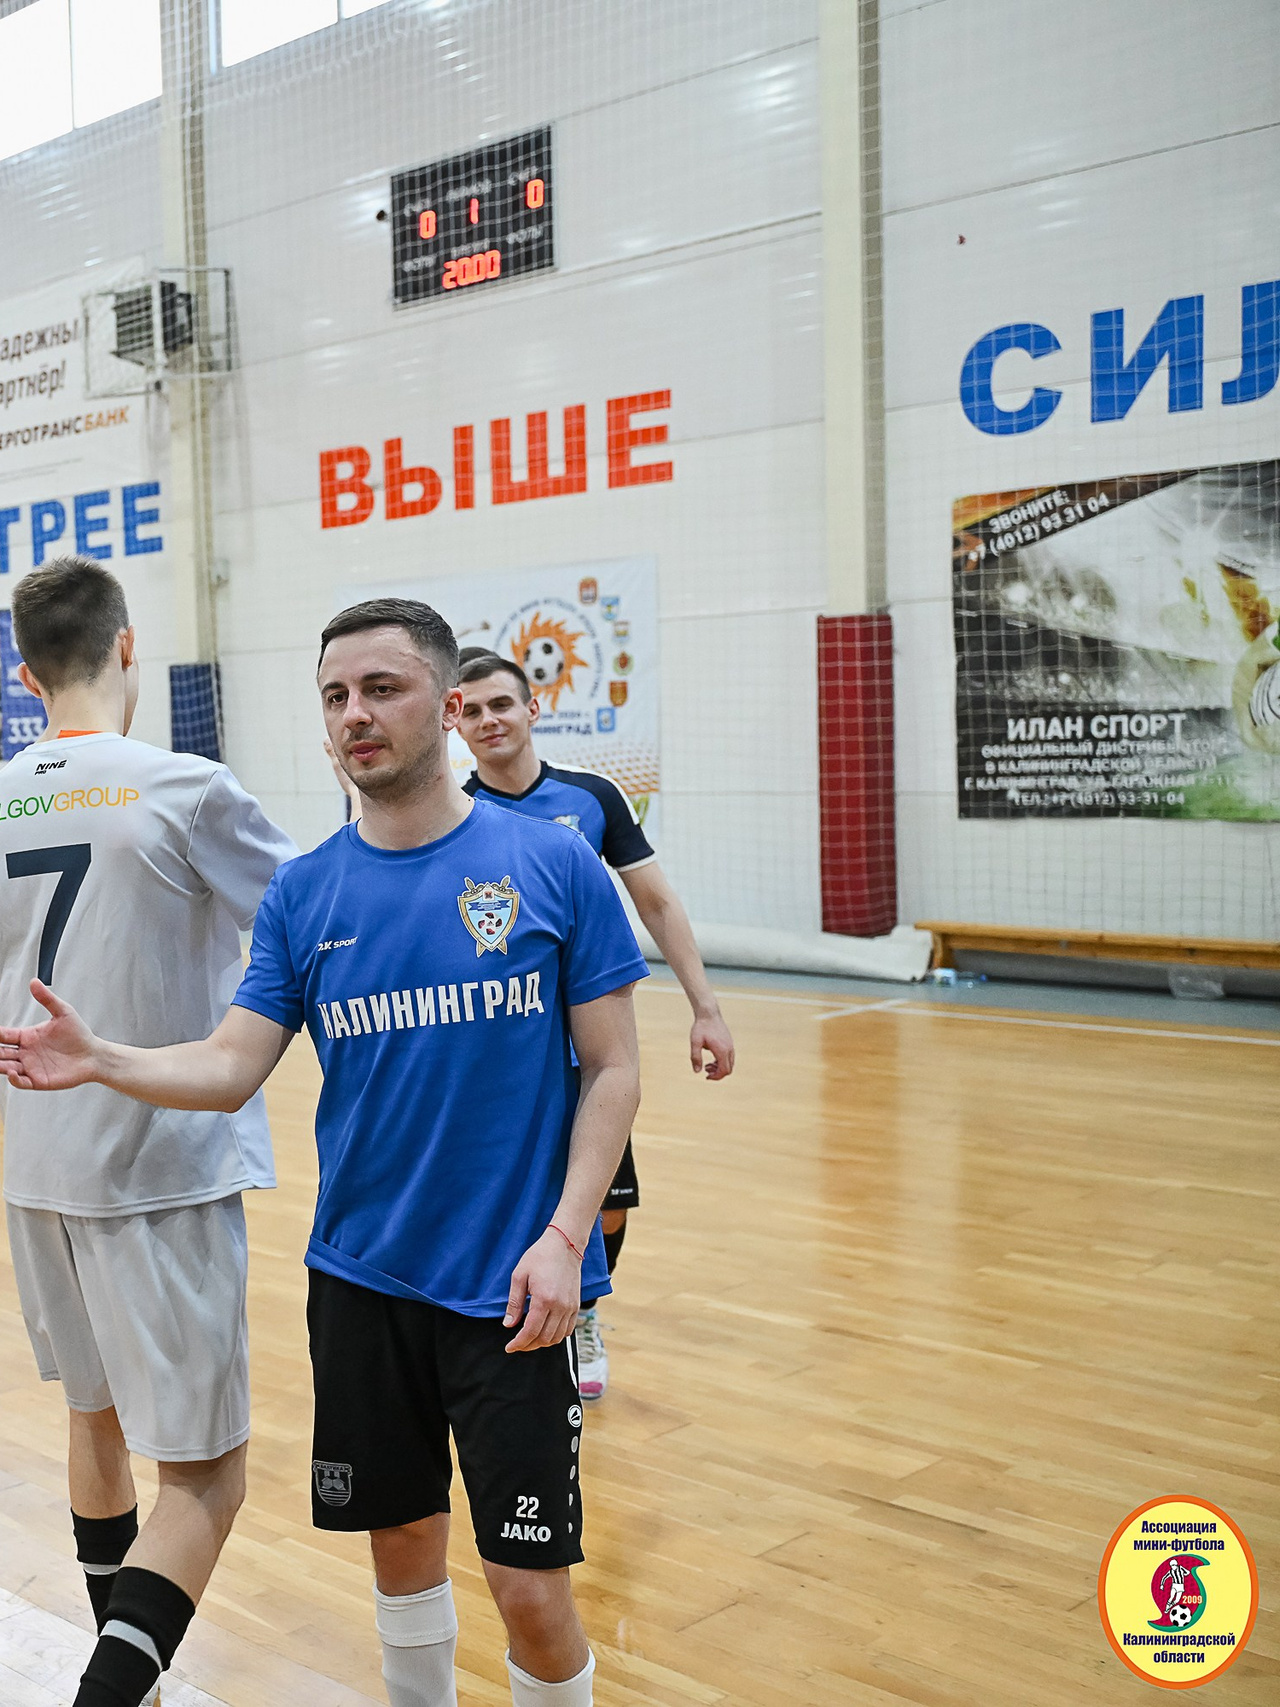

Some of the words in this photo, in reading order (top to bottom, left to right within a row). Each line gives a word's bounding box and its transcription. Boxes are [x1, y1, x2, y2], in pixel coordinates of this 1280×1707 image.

[526, 179, 544, 209] 0
[419, 210, 437, 239] 0
[470, 198, 479, 224] 1
[320, 389, 673, 529] ВЫШЕ
[989, 489, 1069, 533] ЗВОНИТЕ:
[990, 522, 1040, 557] (4012)
[1064, 502, 1084, 523] 31
[1087, 492, 1110, 513] 04
[1007, 716, 1084, 741] ИЛАН
[1090, 713, 1187, 747] СПОРТ
[36, 760, 67, 771] NINE
[5, 842, 92, 986] 7
[333, 936, 359, 949] SPORT
[515, 1495, 540, 1519] 22
[500, 1522, 552, 1543] JAKO
